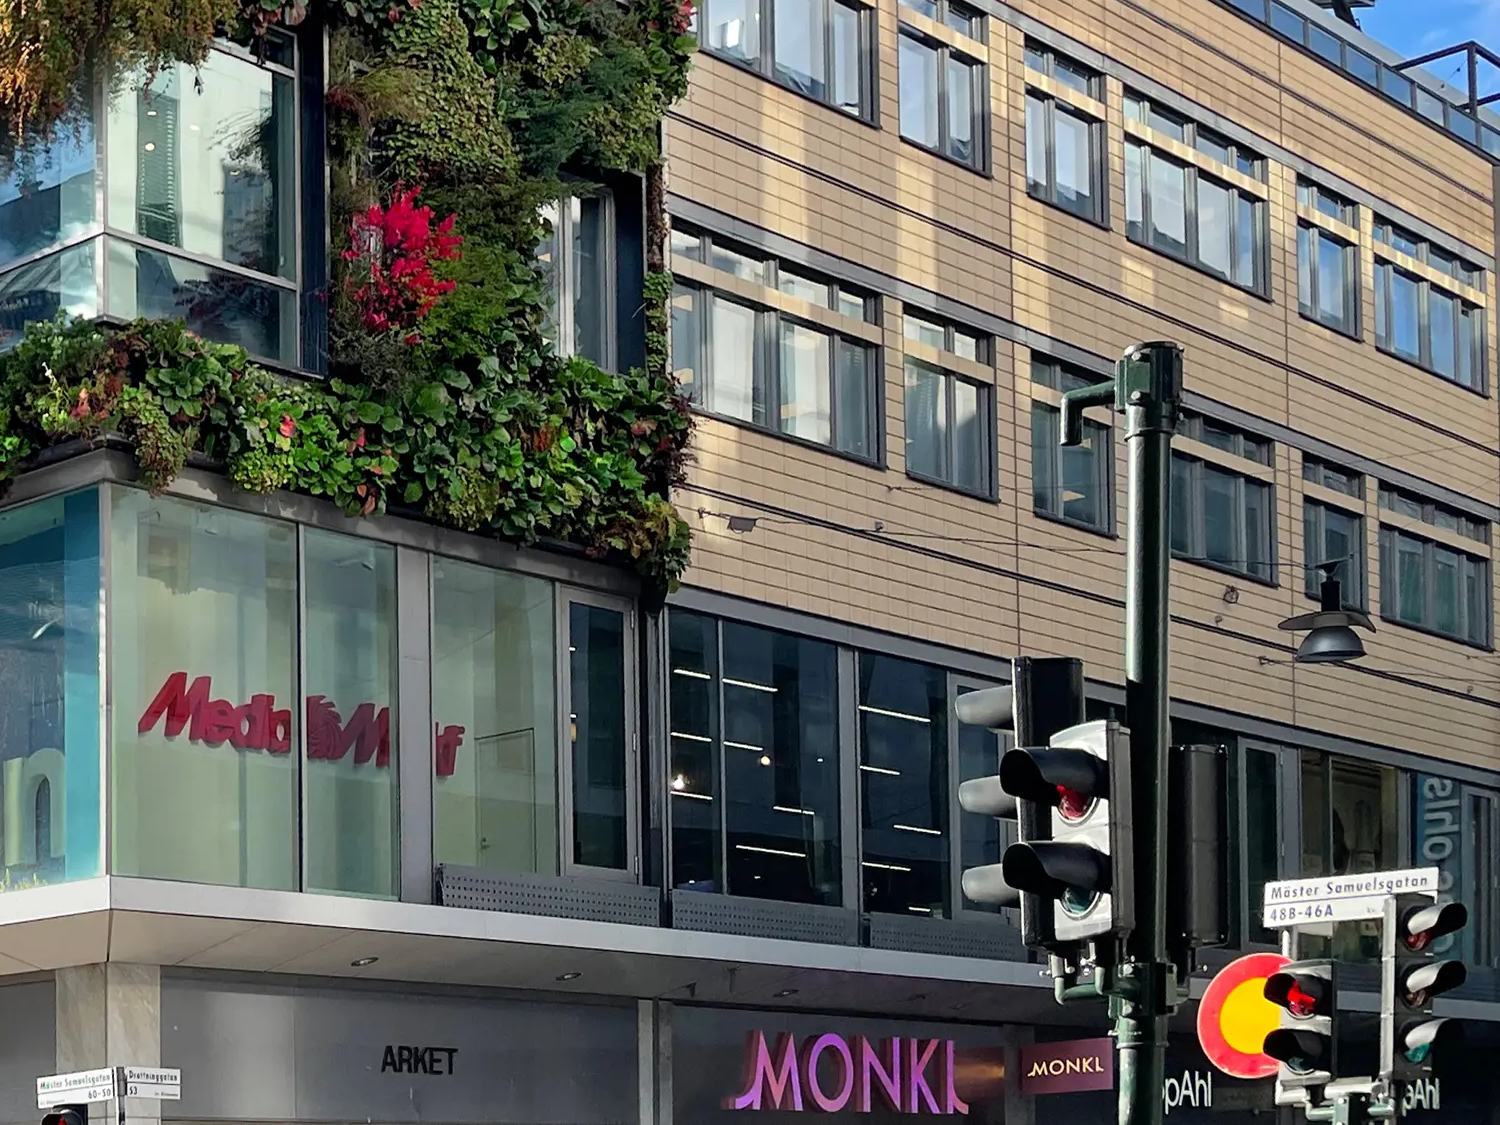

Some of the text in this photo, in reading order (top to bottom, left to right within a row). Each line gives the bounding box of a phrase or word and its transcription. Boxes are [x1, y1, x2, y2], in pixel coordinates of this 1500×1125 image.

[1271, 876, 1428, 900] Mäster Samuelsgatan
[1270, 904, 1333, 921] 48B-46A
[381, 1046, 459, 1075] ARKET
[1027, 1056, 1104, 1077] MONKI
[64, 1073, 111, 1087] Samuelsgatan
[128, 1070, 178, 1082] Drottninggatan
[724, 1030, 969, 1115] MONKI
[1161, 1069, 1212, 1115] pAhl
